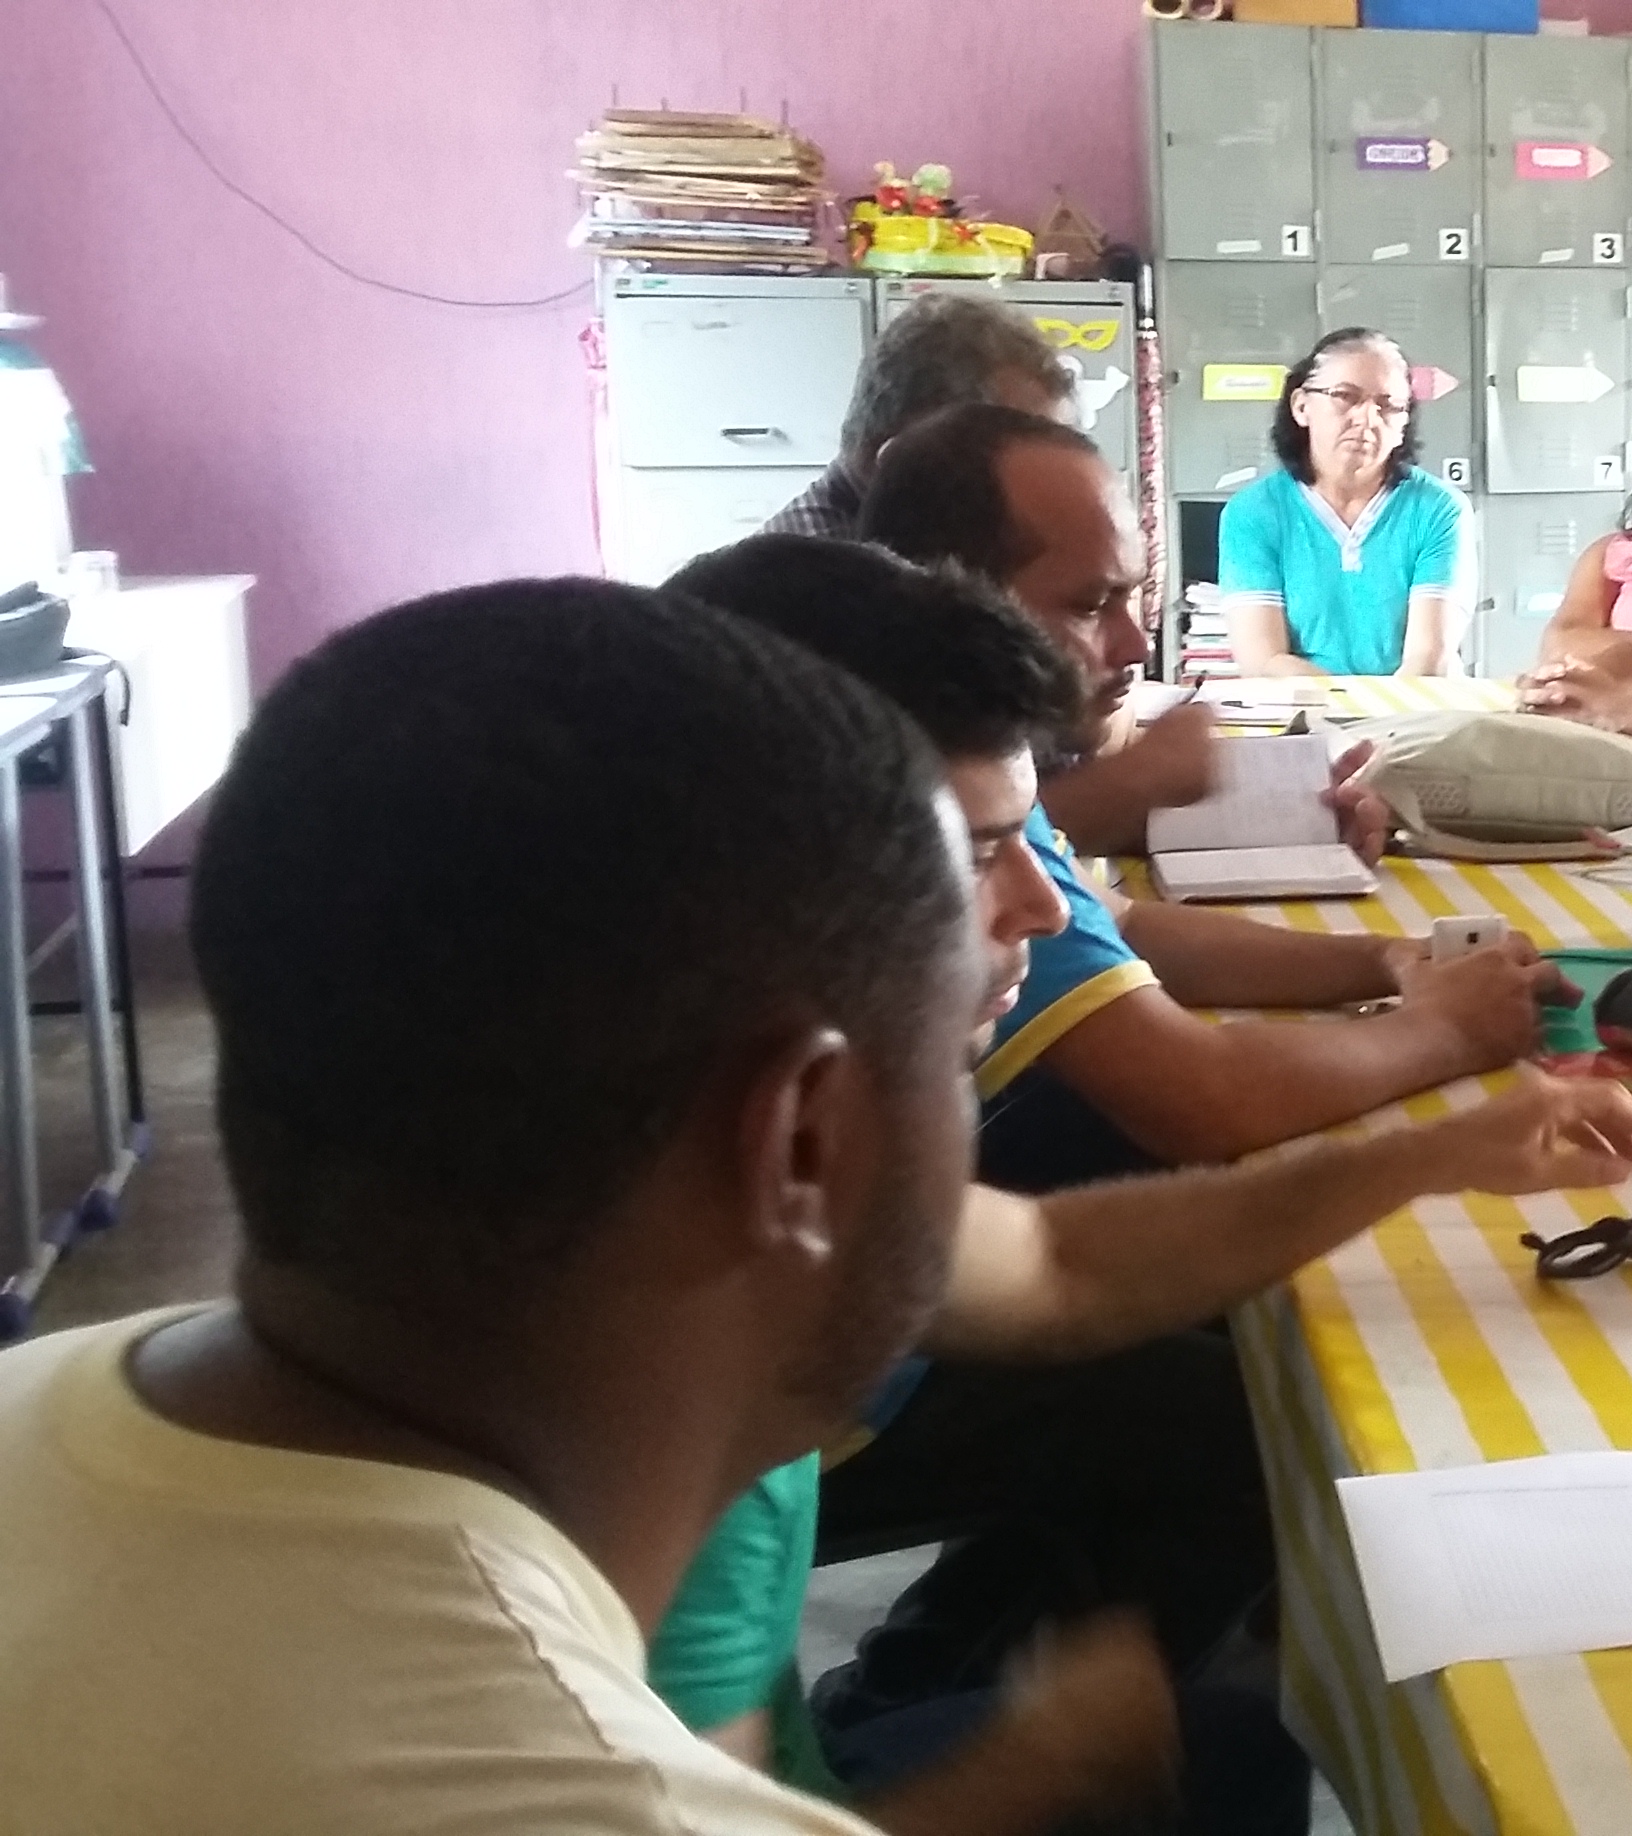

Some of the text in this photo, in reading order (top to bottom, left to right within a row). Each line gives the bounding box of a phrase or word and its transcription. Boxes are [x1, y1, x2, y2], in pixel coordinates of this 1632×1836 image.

[1287, 230, 1298, 252] 1
[1445, 233, 1462, 254] 2
[1600, 237, 1616, 259] 3
[1448, 461, 1463, 481] 6
[1600, 461, 1613, 480] 7
